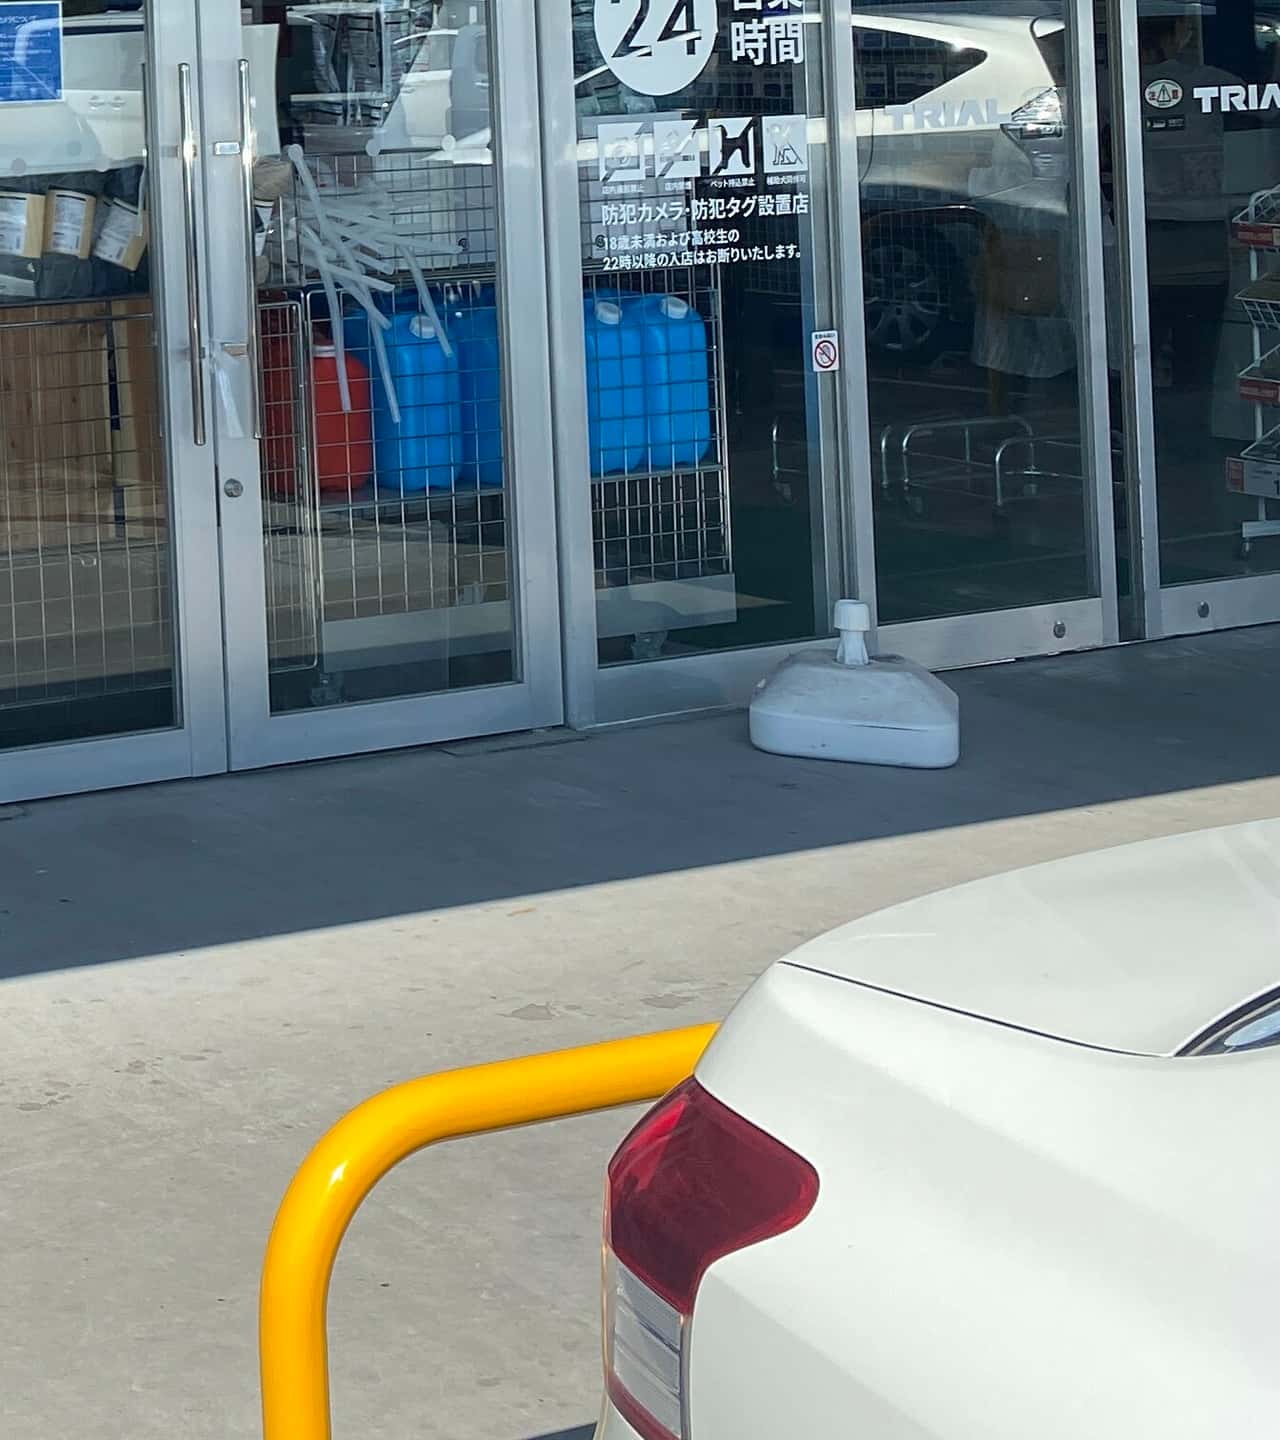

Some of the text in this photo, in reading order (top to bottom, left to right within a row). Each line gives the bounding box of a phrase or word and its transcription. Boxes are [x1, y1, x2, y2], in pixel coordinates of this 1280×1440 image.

[730, 18, 804, 65] 時間
[884, 97, 1013, 130] TRIAL
[601, 193, 809, 226] 防犯カメラ・防犯タグ設置店
[604, 229, 739, 251] 18歳未満および高校生の
[603, 245, 801, 271] 22時以降の入店はお断りいたします。
